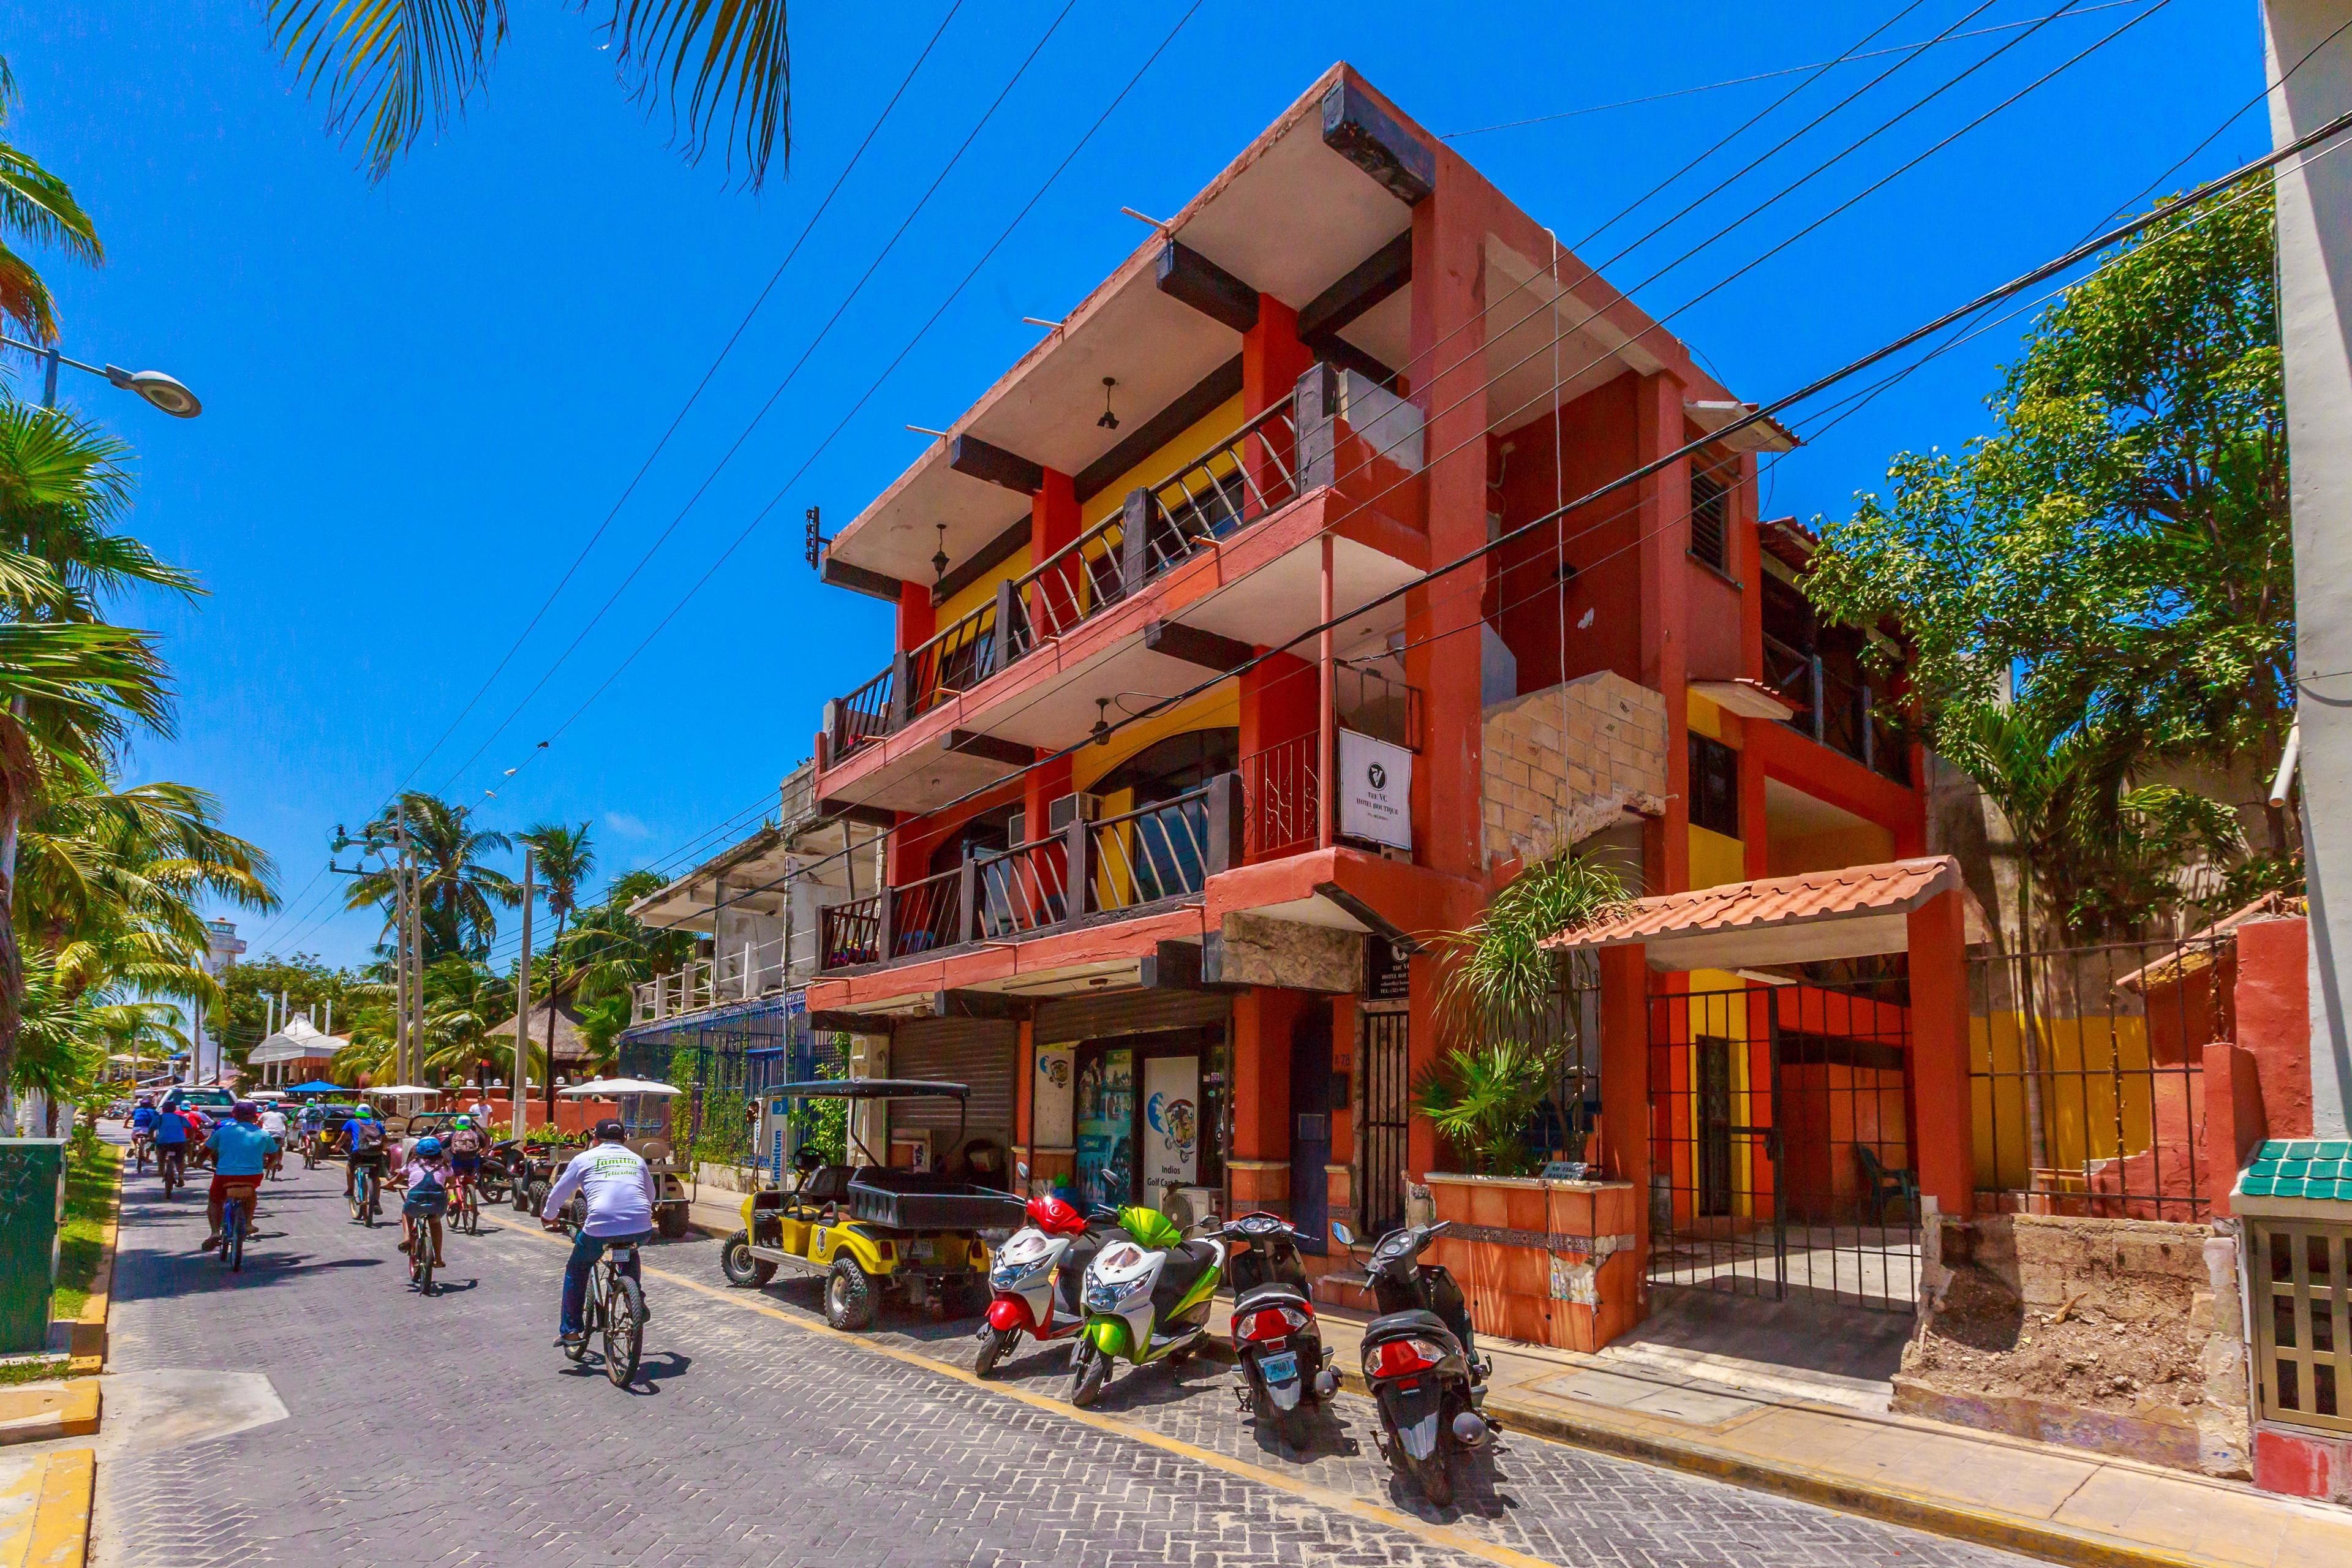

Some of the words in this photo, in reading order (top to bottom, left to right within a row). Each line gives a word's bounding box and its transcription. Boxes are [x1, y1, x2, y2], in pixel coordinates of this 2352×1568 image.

[1379, 793, 1387, 802] VC
[1357, 798, 1372, 807] HOTEL
[1373, 803, 1399, 815] BOUTIQUE
[772, 1130, 781, 1182] infinitum
[1161, 1166, 1180, 1174] Indios
[1147, 1177, 1159, 1186] Golf
